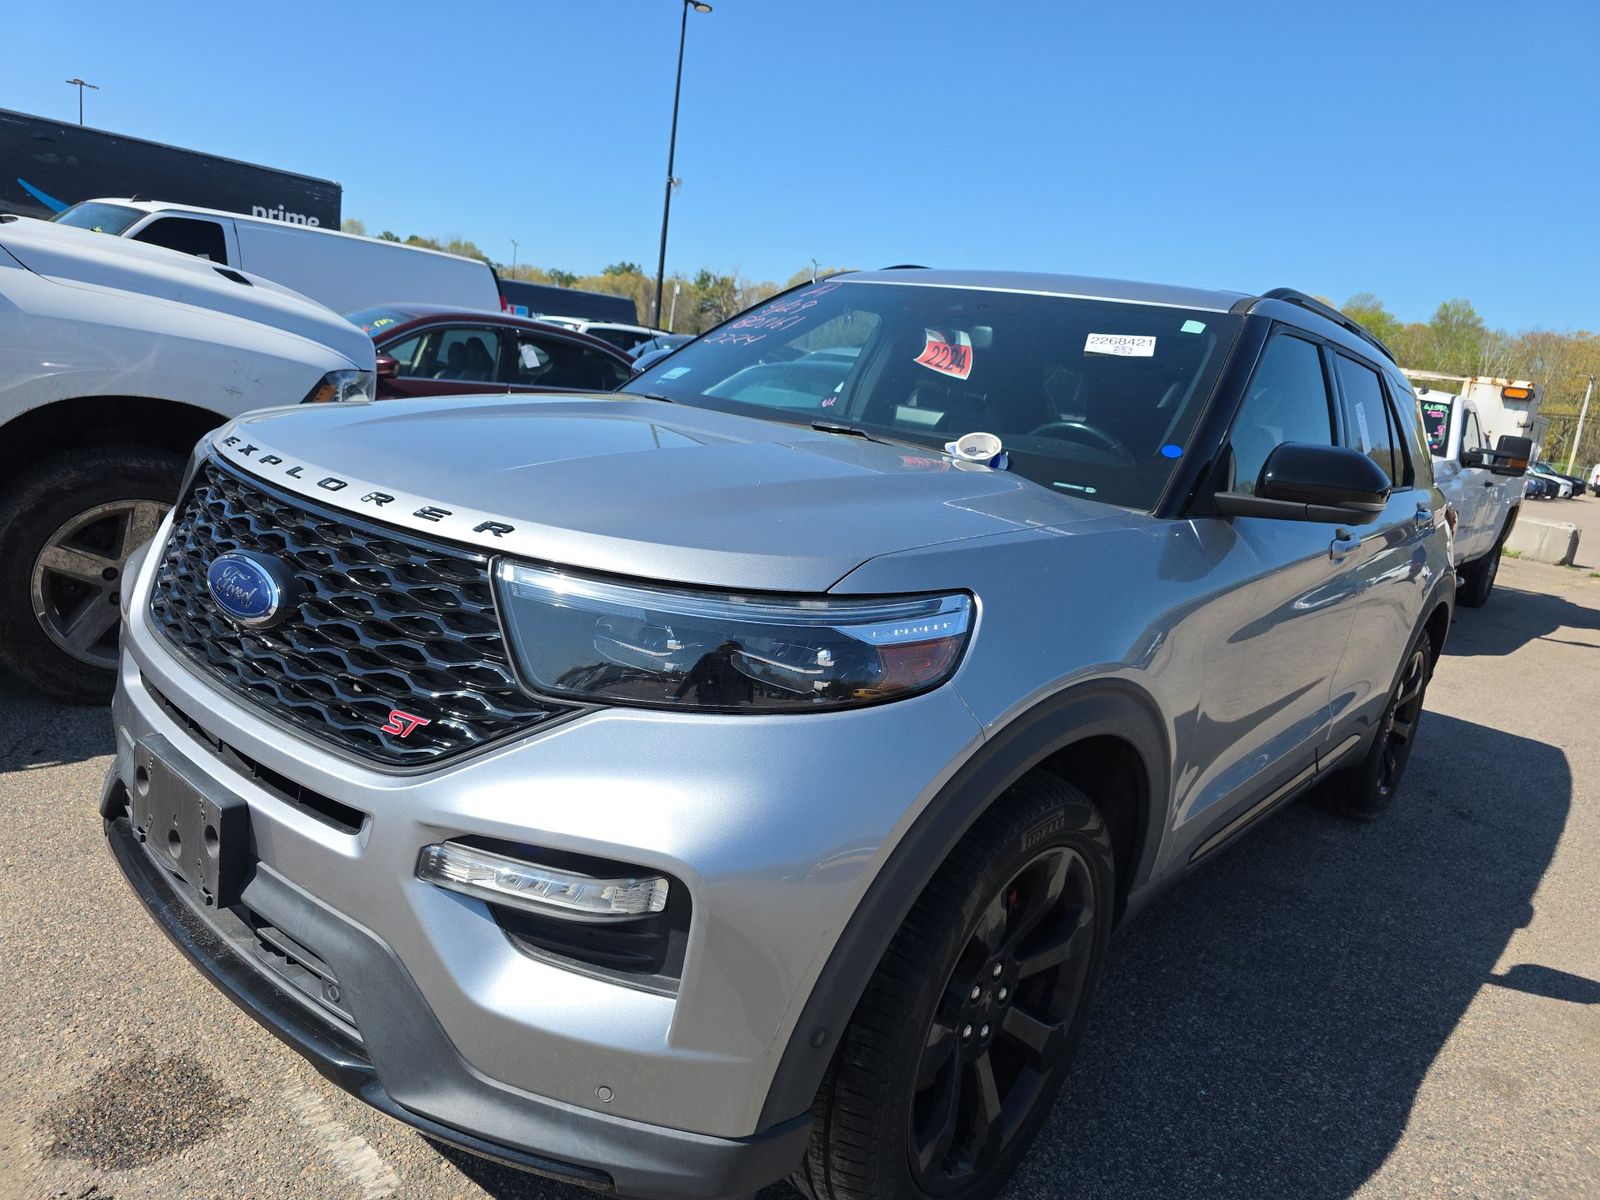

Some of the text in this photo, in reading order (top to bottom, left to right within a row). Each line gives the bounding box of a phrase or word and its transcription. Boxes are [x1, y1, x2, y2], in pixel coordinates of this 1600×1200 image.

[252, 200, 320, 227] prime
[1090, 336, 1153, 347] 2268421
[924, 345, 967, 374] 2224
[222, 435, 516, 539] EXPLORER
[216, 565, 258, 609] Ford
[381, 709, 432, 738] ST
